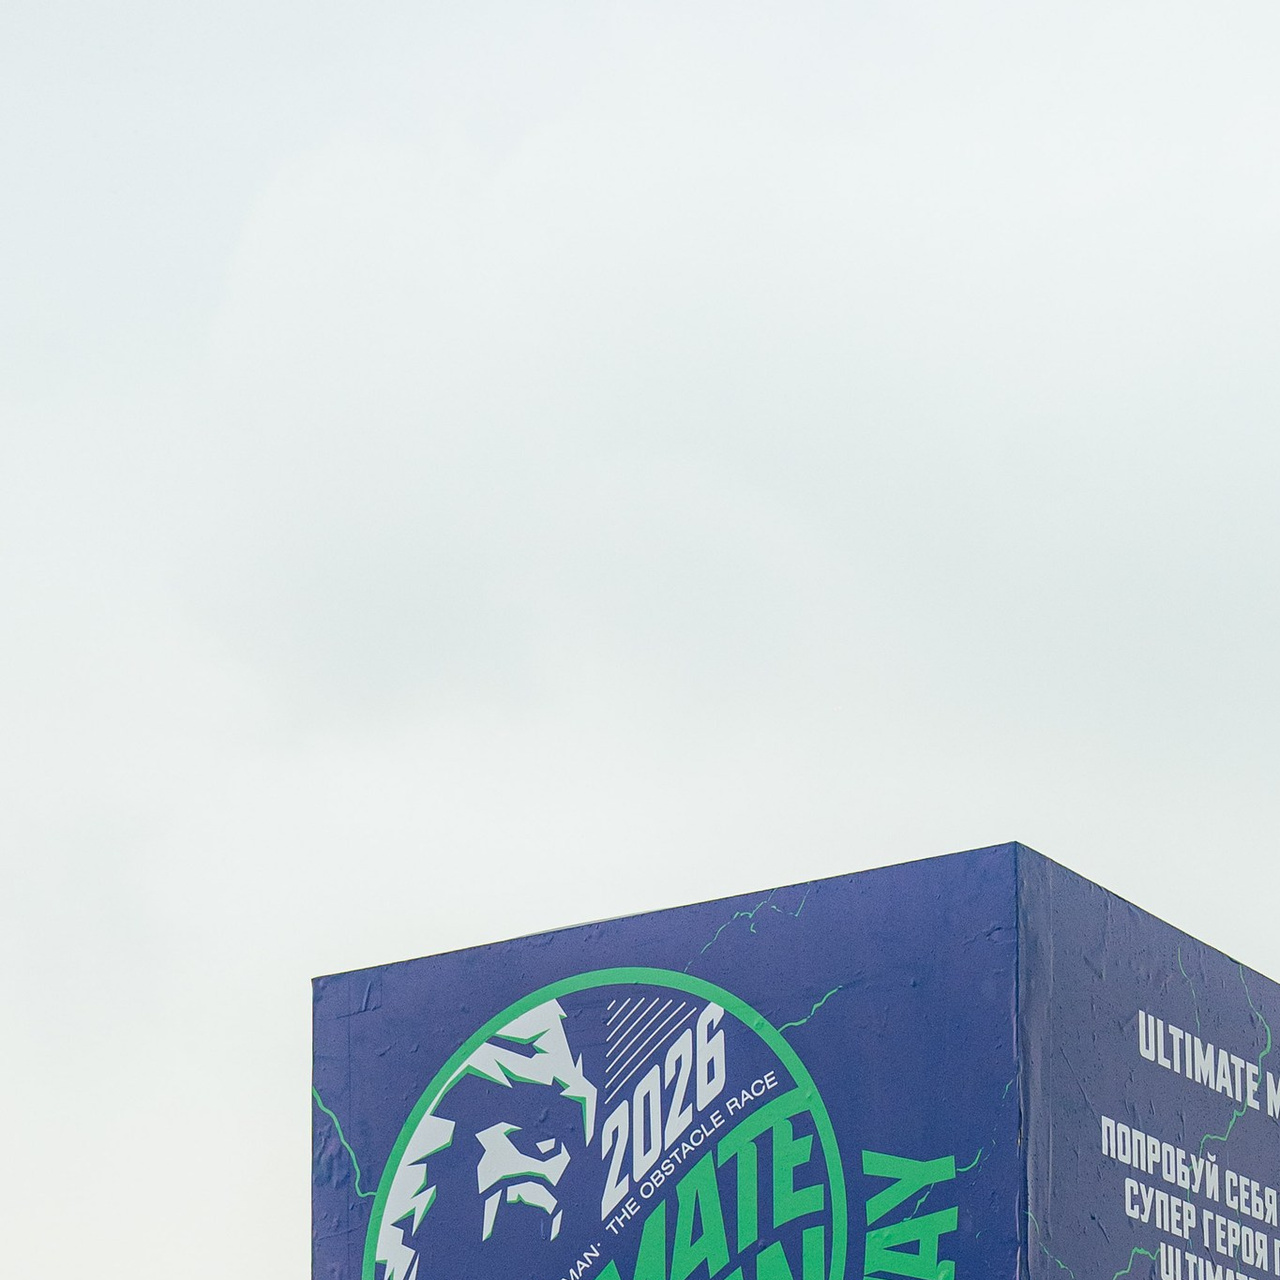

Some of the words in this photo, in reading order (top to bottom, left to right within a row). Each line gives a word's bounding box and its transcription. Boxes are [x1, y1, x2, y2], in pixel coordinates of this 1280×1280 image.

[601, 1001, 726, 1222] 2026
[1138, 1009, 1260, 1111] ULTIMATE
[604, 1196, 642, 1236] THE
[639, 1110, 726, 1200] OBSTACLE
[725, 1070, 779, 1117] RACE
[1101, 1115, 1220, 1203] ПОПРОБУЙ
[1225, 1169, 1278, 1228] СЕБЯ
[1124, 1177, 1197, 1240] СУПЕР
[1202, 1208, 1269, 1272] ГЕРОЯ
